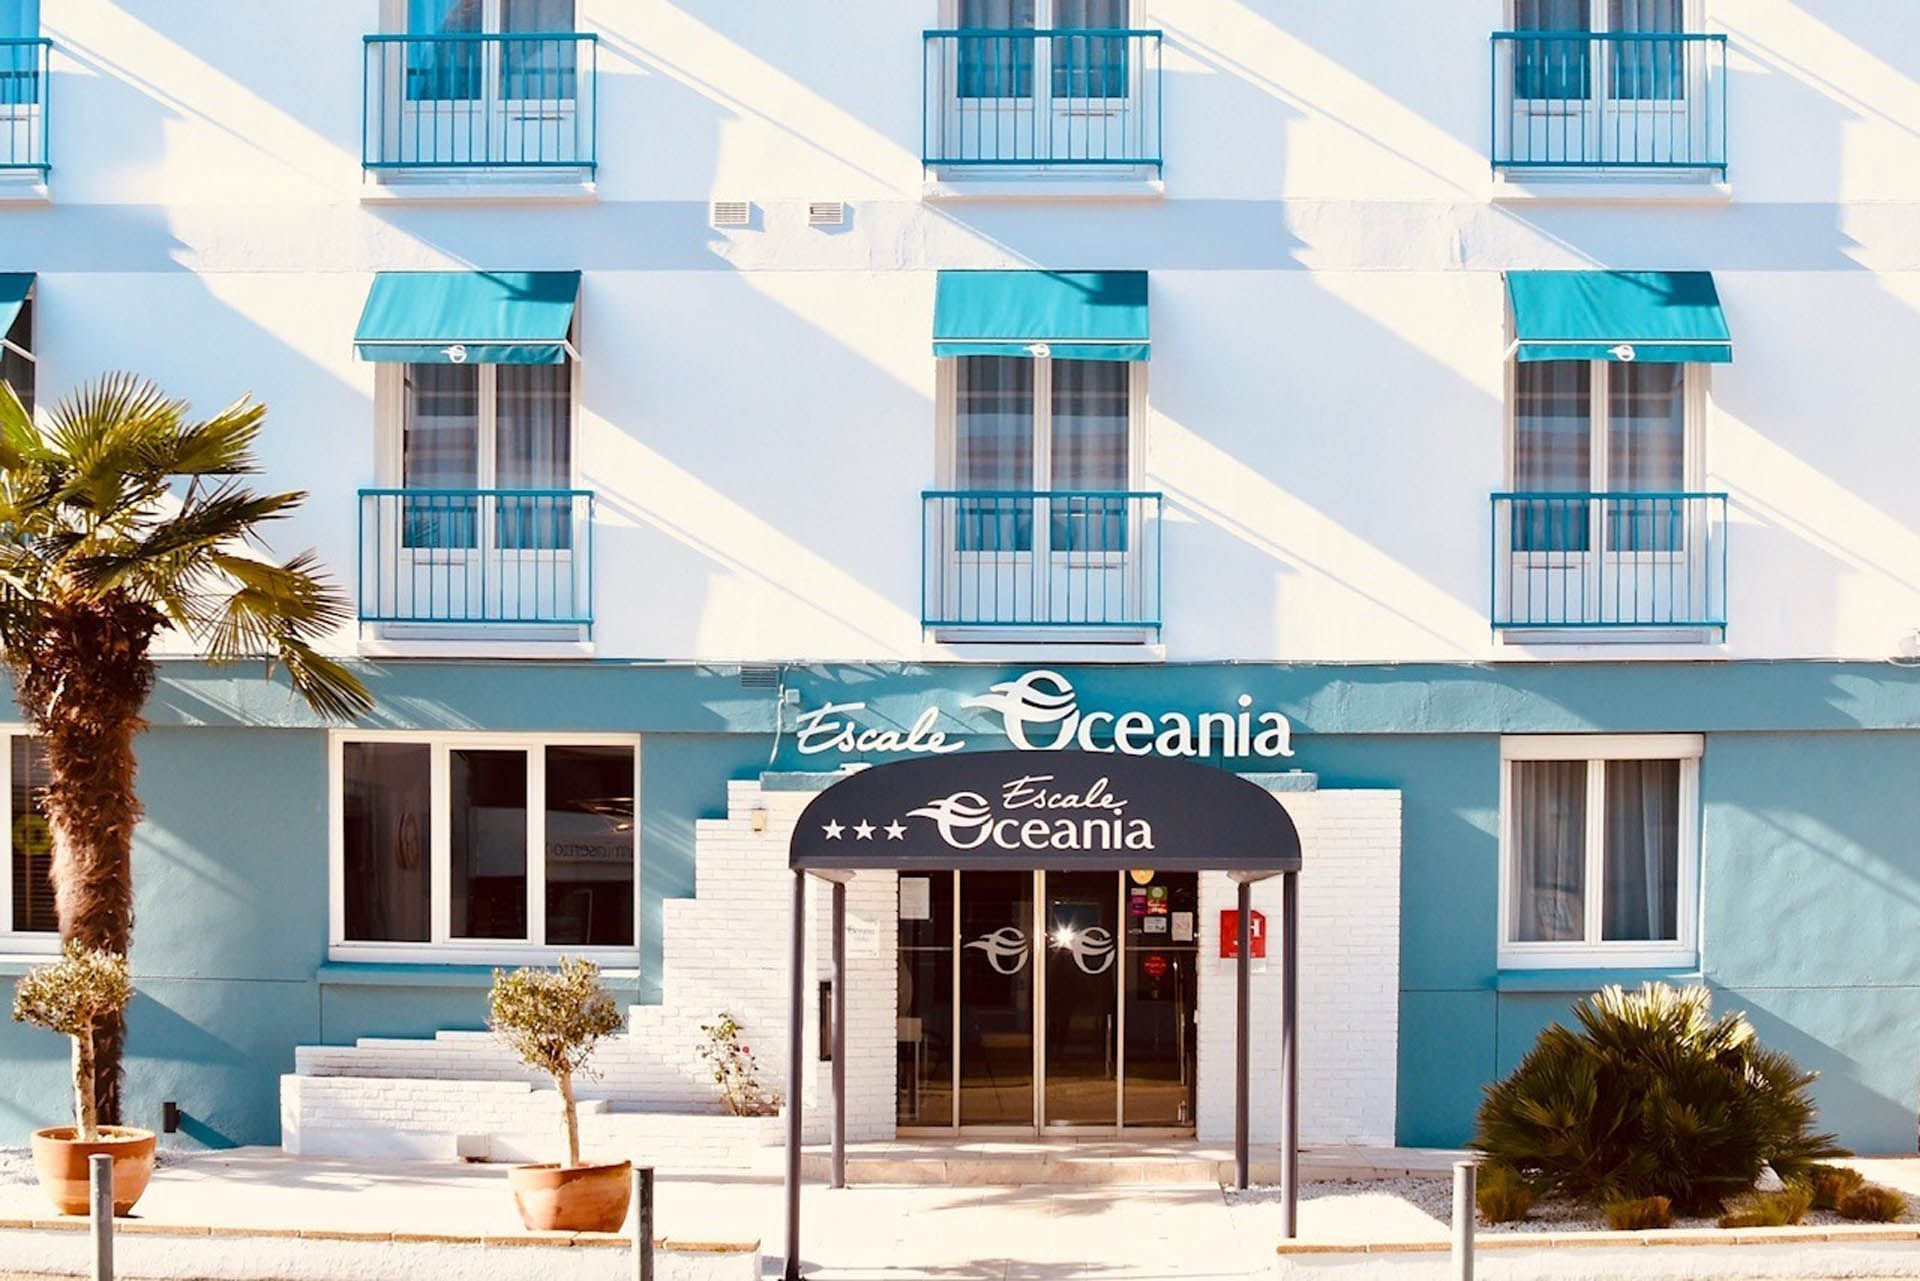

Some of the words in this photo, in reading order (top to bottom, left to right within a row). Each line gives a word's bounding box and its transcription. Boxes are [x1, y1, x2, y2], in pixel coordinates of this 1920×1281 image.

[796, 702, 966, 755] Escale
[961, 669, 1295, 758] Oceania
[905, 791, 1156, 851] Oceania
[1001, 774, 1128, 811] Escale
